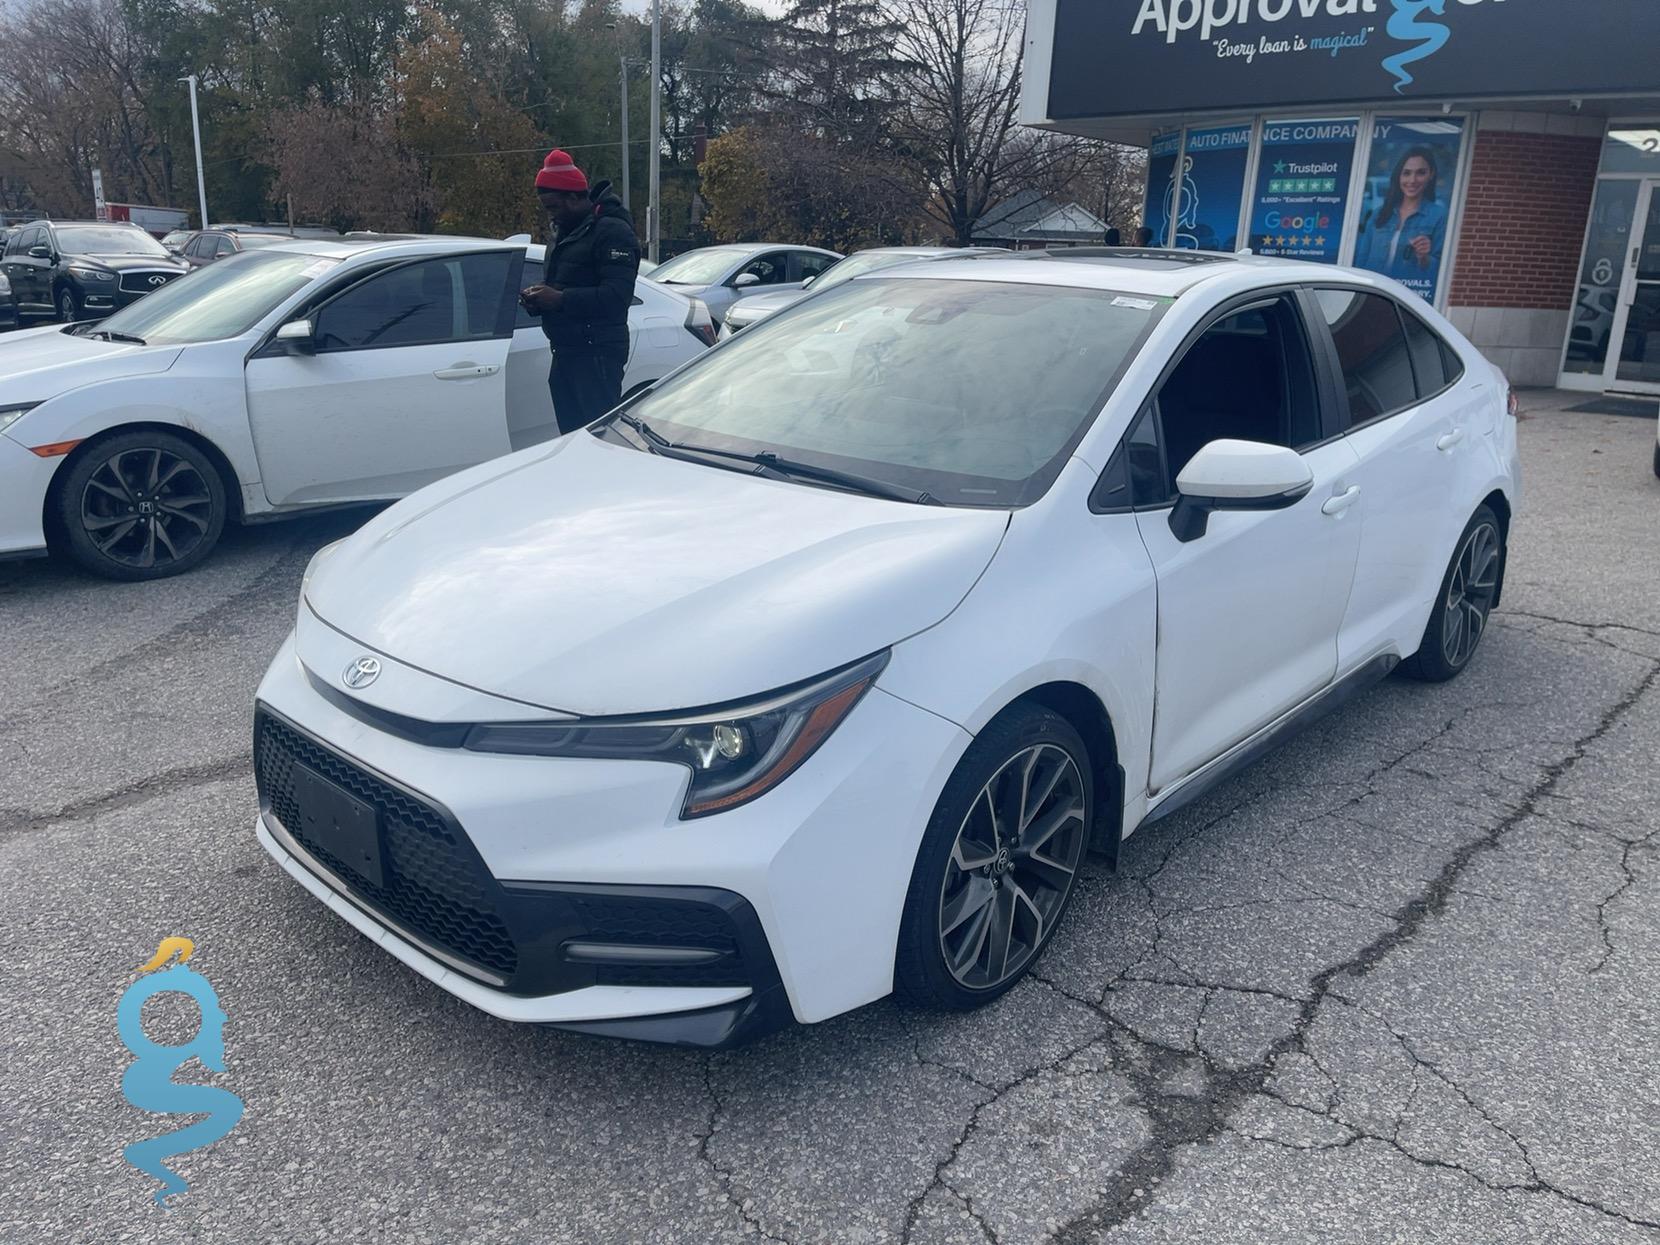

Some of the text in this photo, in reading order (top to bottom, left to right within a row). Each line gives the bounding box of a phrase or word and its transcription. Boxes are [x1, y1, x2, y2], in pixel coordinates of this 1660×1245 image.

[1131, 0, 1377, 43] Approv
[1259, 36, 1290, 54] loan
[1293, 35, 1307, 51] is
[1189, 133, 1220, 149] AUTO
[1288, 163, 1338, 174] Trustpilot
[1265, 211, 1330, 233] Google
